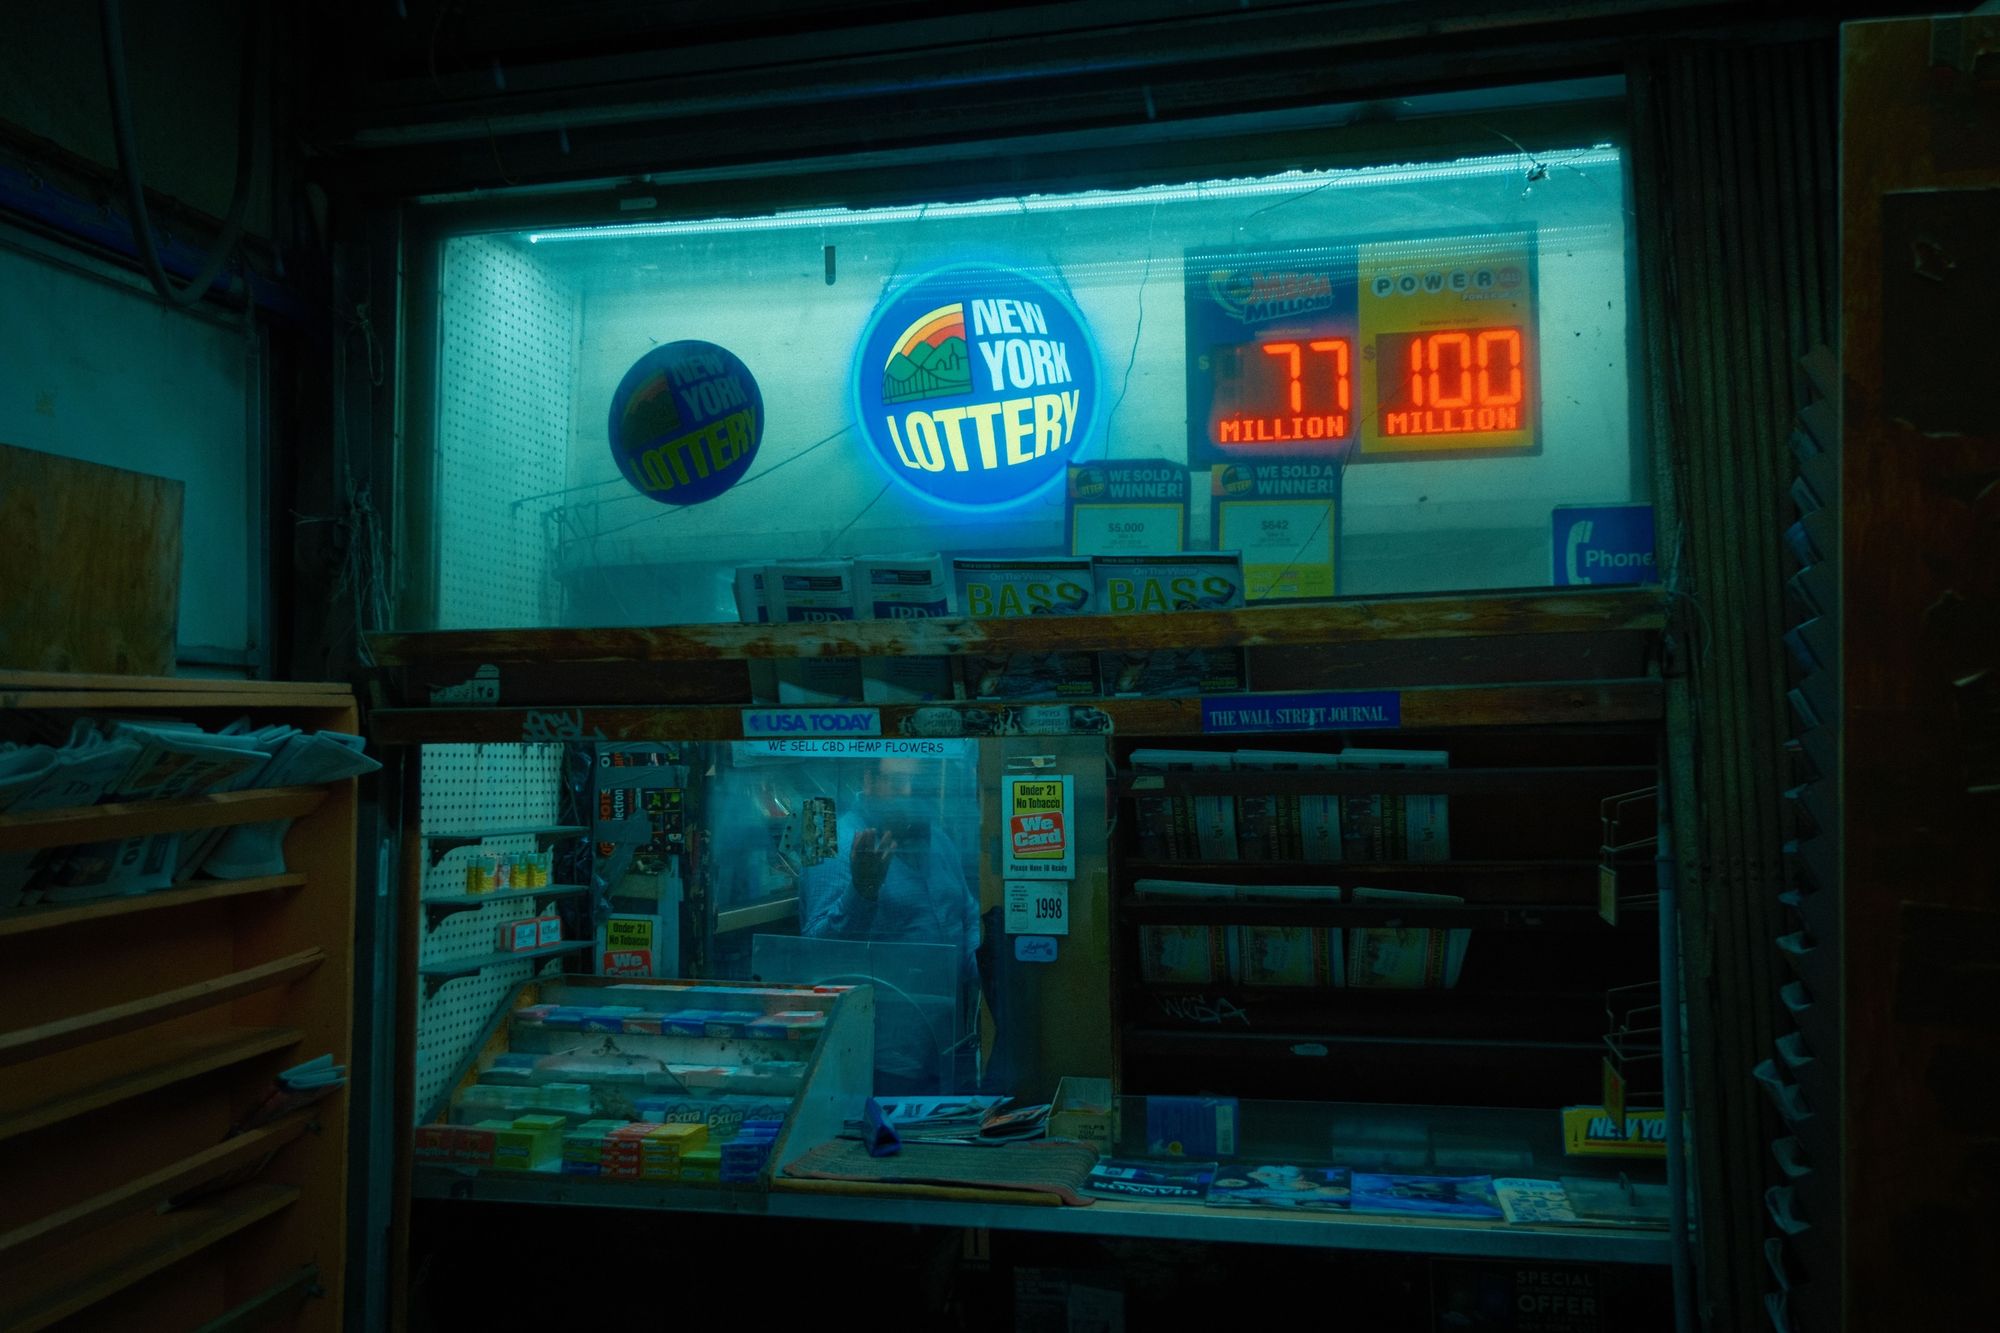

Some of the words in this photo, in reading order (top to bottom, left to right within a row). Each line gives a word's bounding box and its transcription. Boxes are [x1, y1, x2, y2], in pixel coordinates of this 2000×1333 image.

[1376, 271, 1493, 294] POWER
[971, 299, 1049, 336] NEW
[670, 352, 726, 386] NEW
[979, 338, 1073, 392] YORK
[1410, 329, 1523, 409] 100
[1263, 339, 1349, 414] 77
[679, 374, 749, 422] YORK
[886, 389, 1080, 473] LOTTERY
[1219, 415, 1345, 443] MILLION
[1386, 406, 1518, 435] MILLION
[628, 404, 758, 492] LOTTERY
[1108, 469, 1134, 483] WE
[1136, 467, 1172, 482] SOLD
[1173, 468, 1184, 482] A
[1256, 465, 1280, 480] WE
[1281, 464, 1319, 479] SOLD
[1322, 463, 1335, 477] A
[1108, 482, 1184, 498] WINNER!
[1256, 478, 1335, 495] WINNER!
[1585, 549, 1654, 568] Phone
[966, 581, 1086, 617] BASS
[1106, 576, 1234, 615] BASS
[766, 714, 808, 732] USA
[809, 713, 874, 732] TODAY
[1209, 710, 1237, 727] THE
[1238, 709, 1274, 725] WALL
[1274, 707, 1327, 725] STREET
[1327, 705, 1389, 722] JOURNAL
[767, 741, 787, 752] WE
[791, 741, 819, 752] SELL
[821, 741, 846, 752] CBD
[849, 741, 882, 752] HEMP
[884, 741, 945, 753] FLOWERS
[1020, 784, 1042, 797] Under
[1043, 784, 1056, 796] 21
[1016, 797, 1027, 809] No
[1028, 796, 1061, 809] Tobacco
[1019, 815, 1055, 833] We
[1013, 826, 1064, 848] Card
[1010, 864, 1028, 873] Please
[1051, 864, 1068, 874] Ready
[1035, 897, 1063, 919] 1998
[612, 922, 634, 934] Under
[636, 923, 647, 934] 21
[609, 935, 620, 946] No
[620, 936, 650, 947] Tobacco
[667, 1110, 701, 1124] Extra
[708, 1111, 744, 1129] Extra
[1516, 1270, 1594, 1288] SPECIAL
[1516, 1294, 1598, 1316] OFFER
